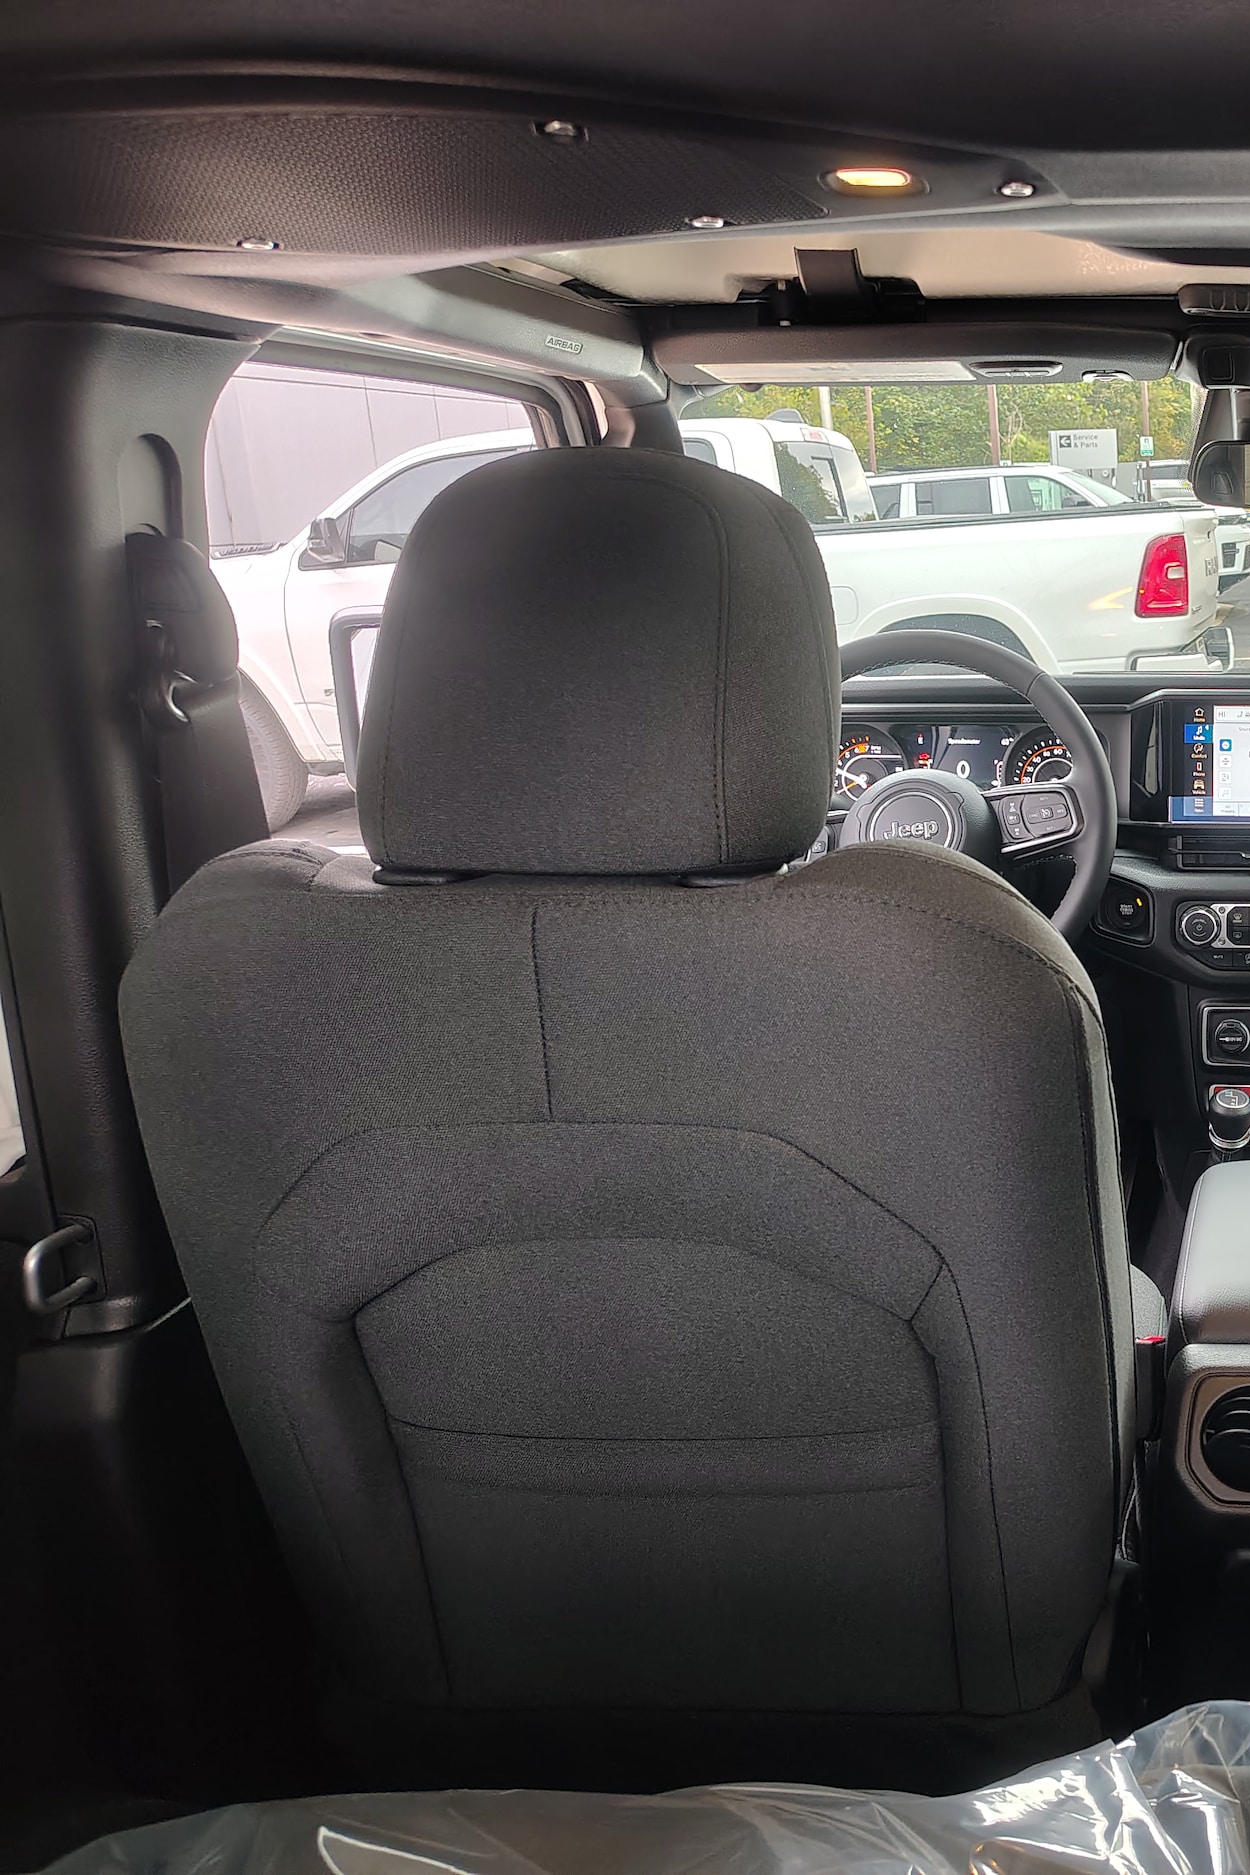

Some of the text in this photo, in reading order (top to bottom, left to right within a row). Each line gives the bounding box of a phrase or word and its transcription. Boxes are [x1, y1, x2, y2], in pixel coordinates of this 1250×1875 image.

[547, 337, 580, 352] AIRBAG
[1218, 710, 1226, 718] HI
[956, 760, 971, 779] 0
[883, 821, 939, 840] Jeep
